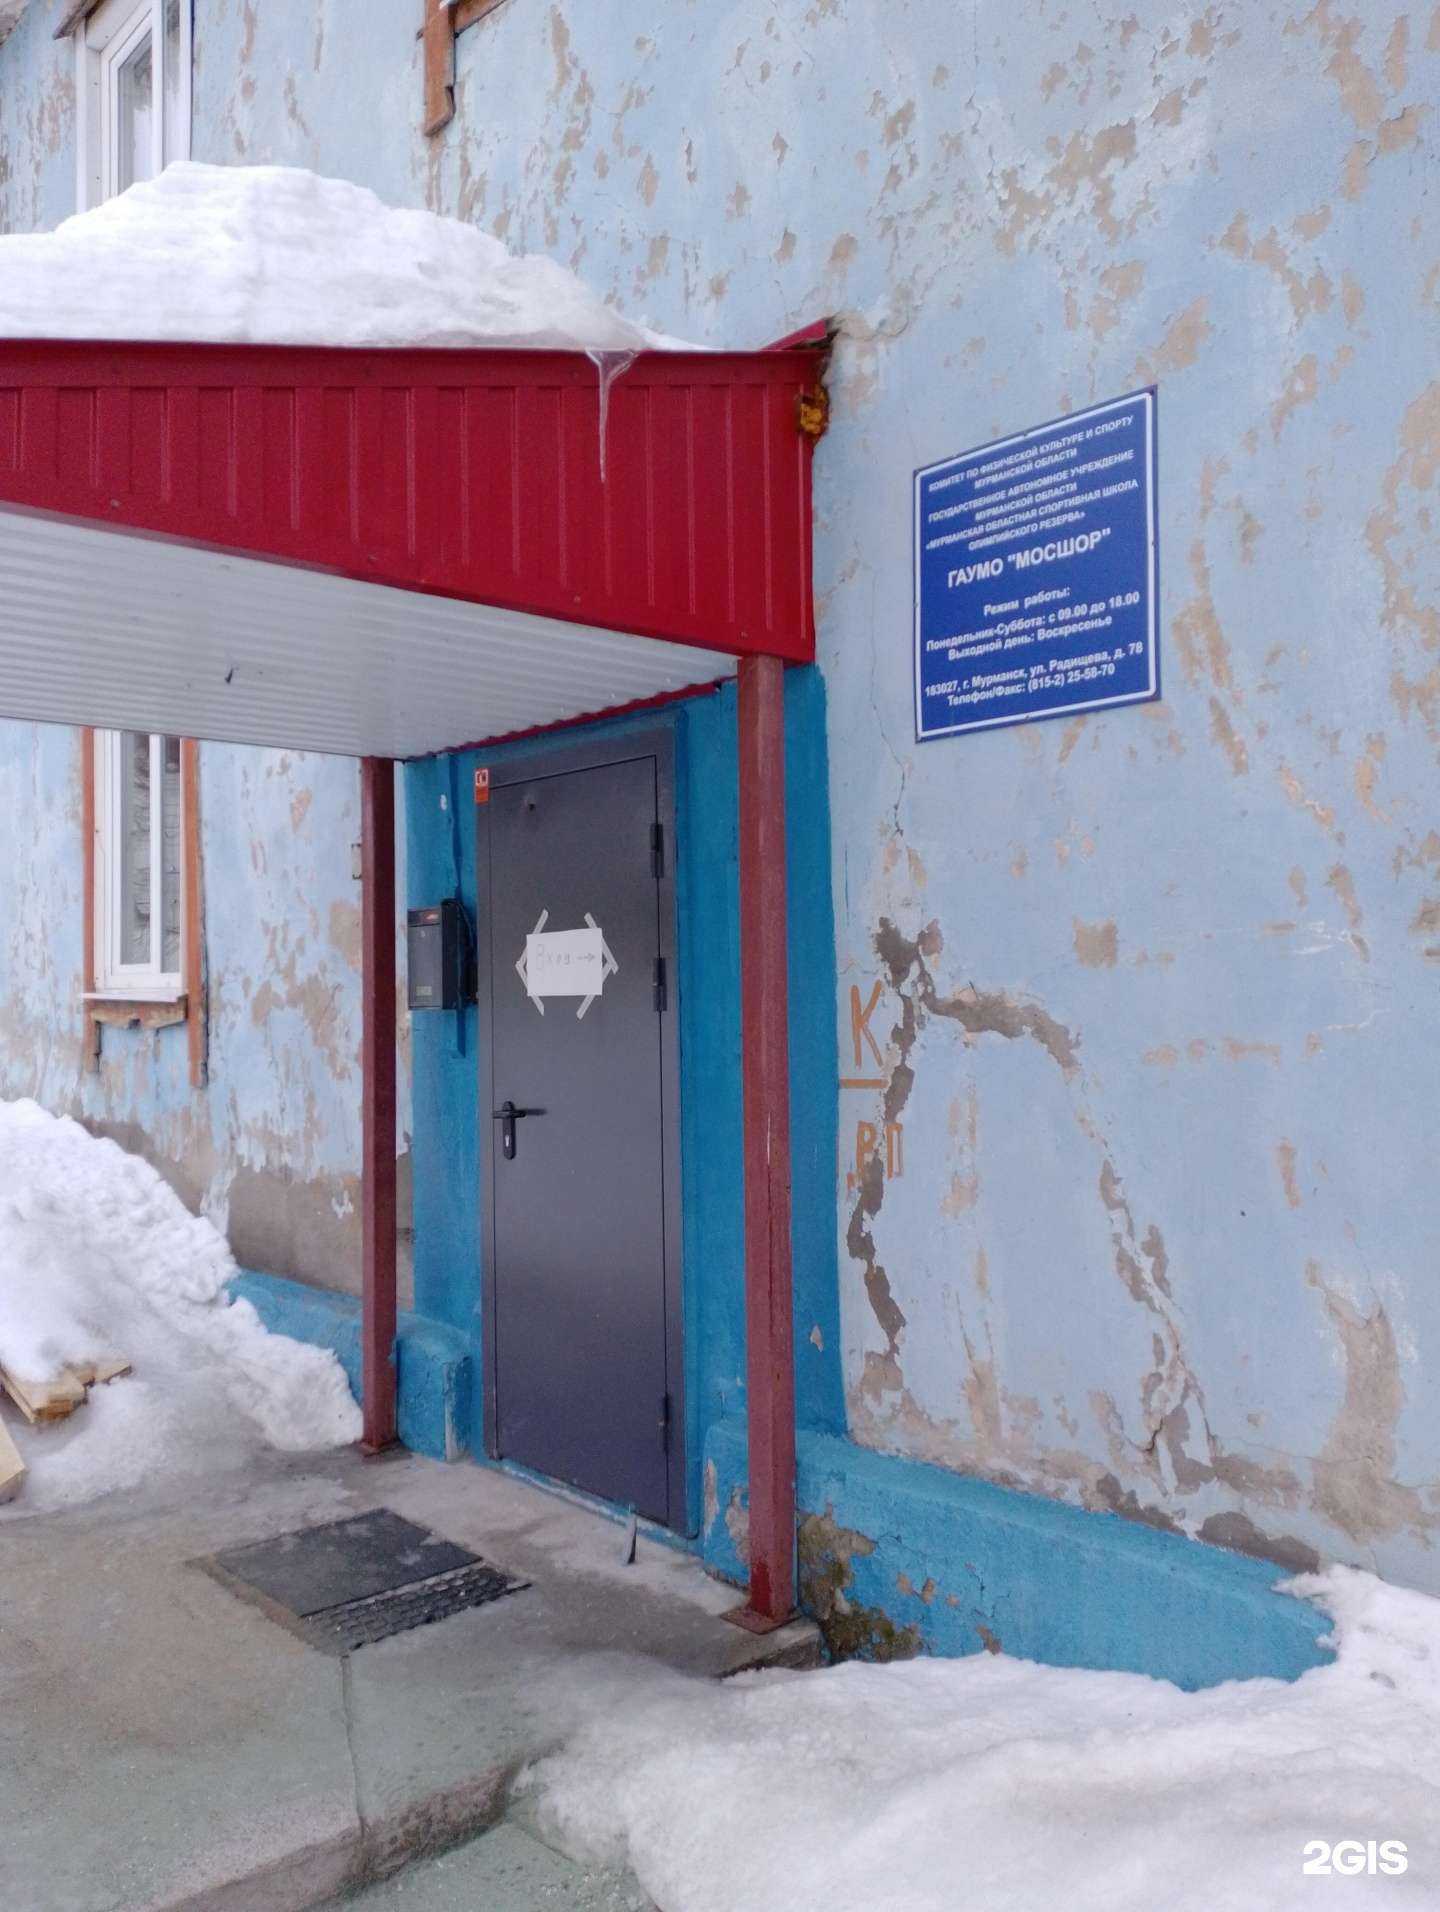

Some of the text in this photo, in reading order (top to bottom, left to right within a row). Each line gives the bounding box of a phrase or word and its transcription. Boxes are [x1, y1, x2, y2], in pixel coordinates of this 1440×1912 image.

[928, 415, 1134, 492] КОМИТЕТ ПО ФИЗИЧЕСКОЙ КУЛЬТУРЕ И СПОРТУ
[974, 448, 1077, 489] МУРМАНСКОЙ ОБЛАСТИ
[928, 449, 1135, 522] ГОСУДАРСТВЕННОЕ АВТОНОМНОЕ УЧРЕЖДЕНИЕ
[975, 483, 1077, 521] МУРМАНСКОЙ ОБЛАСТИ
[926, 479, 1138, 549] «МУРМАНСКАЯ ОБЛАСТНАЯ СПОРТИВНАЯ ШКОЛА
[968, 511, 1085, 551] ОЛИМПИЙСКОГО РЕЗЕРВА»
[947, 528, 1111, 588] ГАУМО "МОСШОР"
[926, 591, 1140, 652] Понедельник-Суббота: с 09.00 до 18.00
[984, 587, 1071, 616] Режим работы:
[948, 615, 1113, 660] Выходной день: Воскресенье
[925, 642, 1143, 697] 183027, г. Мурманск, ул. Радищева, д. 78
[948, 663, 1115, 706] Телефон/Факс: (815-2) 25-58-70
